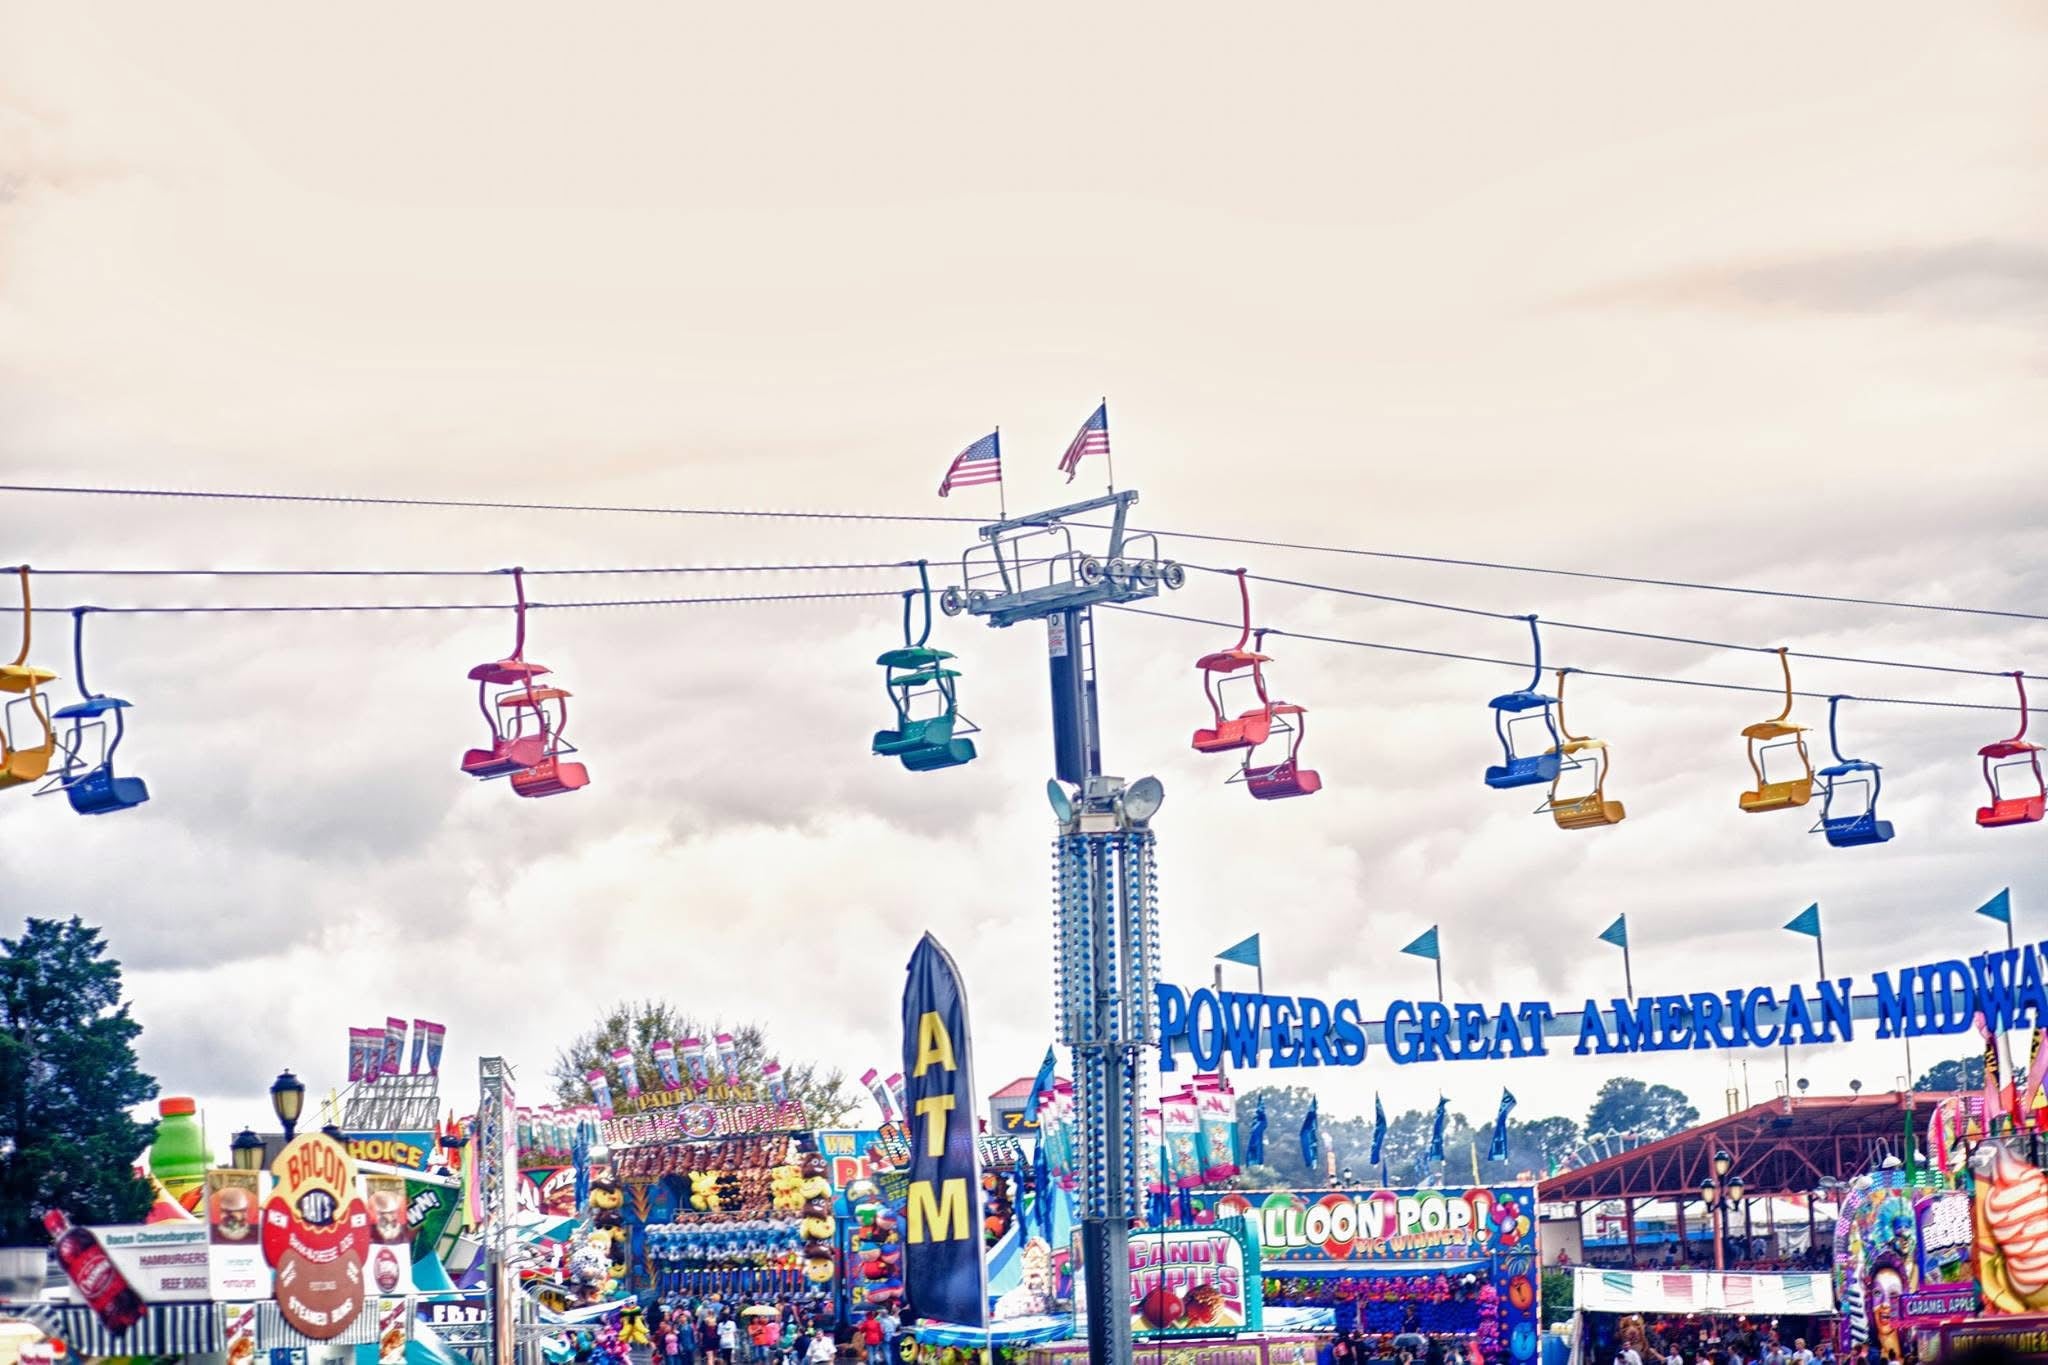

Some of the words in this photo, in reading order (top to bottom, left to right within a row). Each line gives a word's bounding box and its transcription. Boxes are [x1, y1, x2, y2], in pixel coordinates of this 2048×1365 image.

[1154, 983, 1367, 1072] POWERS
[1384, 999, 1556, 1065] GREAT
[1573, 977, 1853, 1055] AMERICAN
[1871, 940, 2048, 1040] MIDWA
[905, 1010, 971, 1244] ATM
[287, 1140, 347, 1198] BACON
[347, 1139, 425, 1169] HOICE
[1397, 1196, 1487, 1243] POP!
[106, 1234, 134, 1245] Bacon
[136, 1231, 206, 1245] Cheeseburgers
[1129, 1237, 1230, 1269] CANDY
[139, 1252, 208, 1267] HAMBURGERS
[1906, 1301, 1946, 1315] CARAMEL
[1949, 1298, 1976, 1313] APPLE
